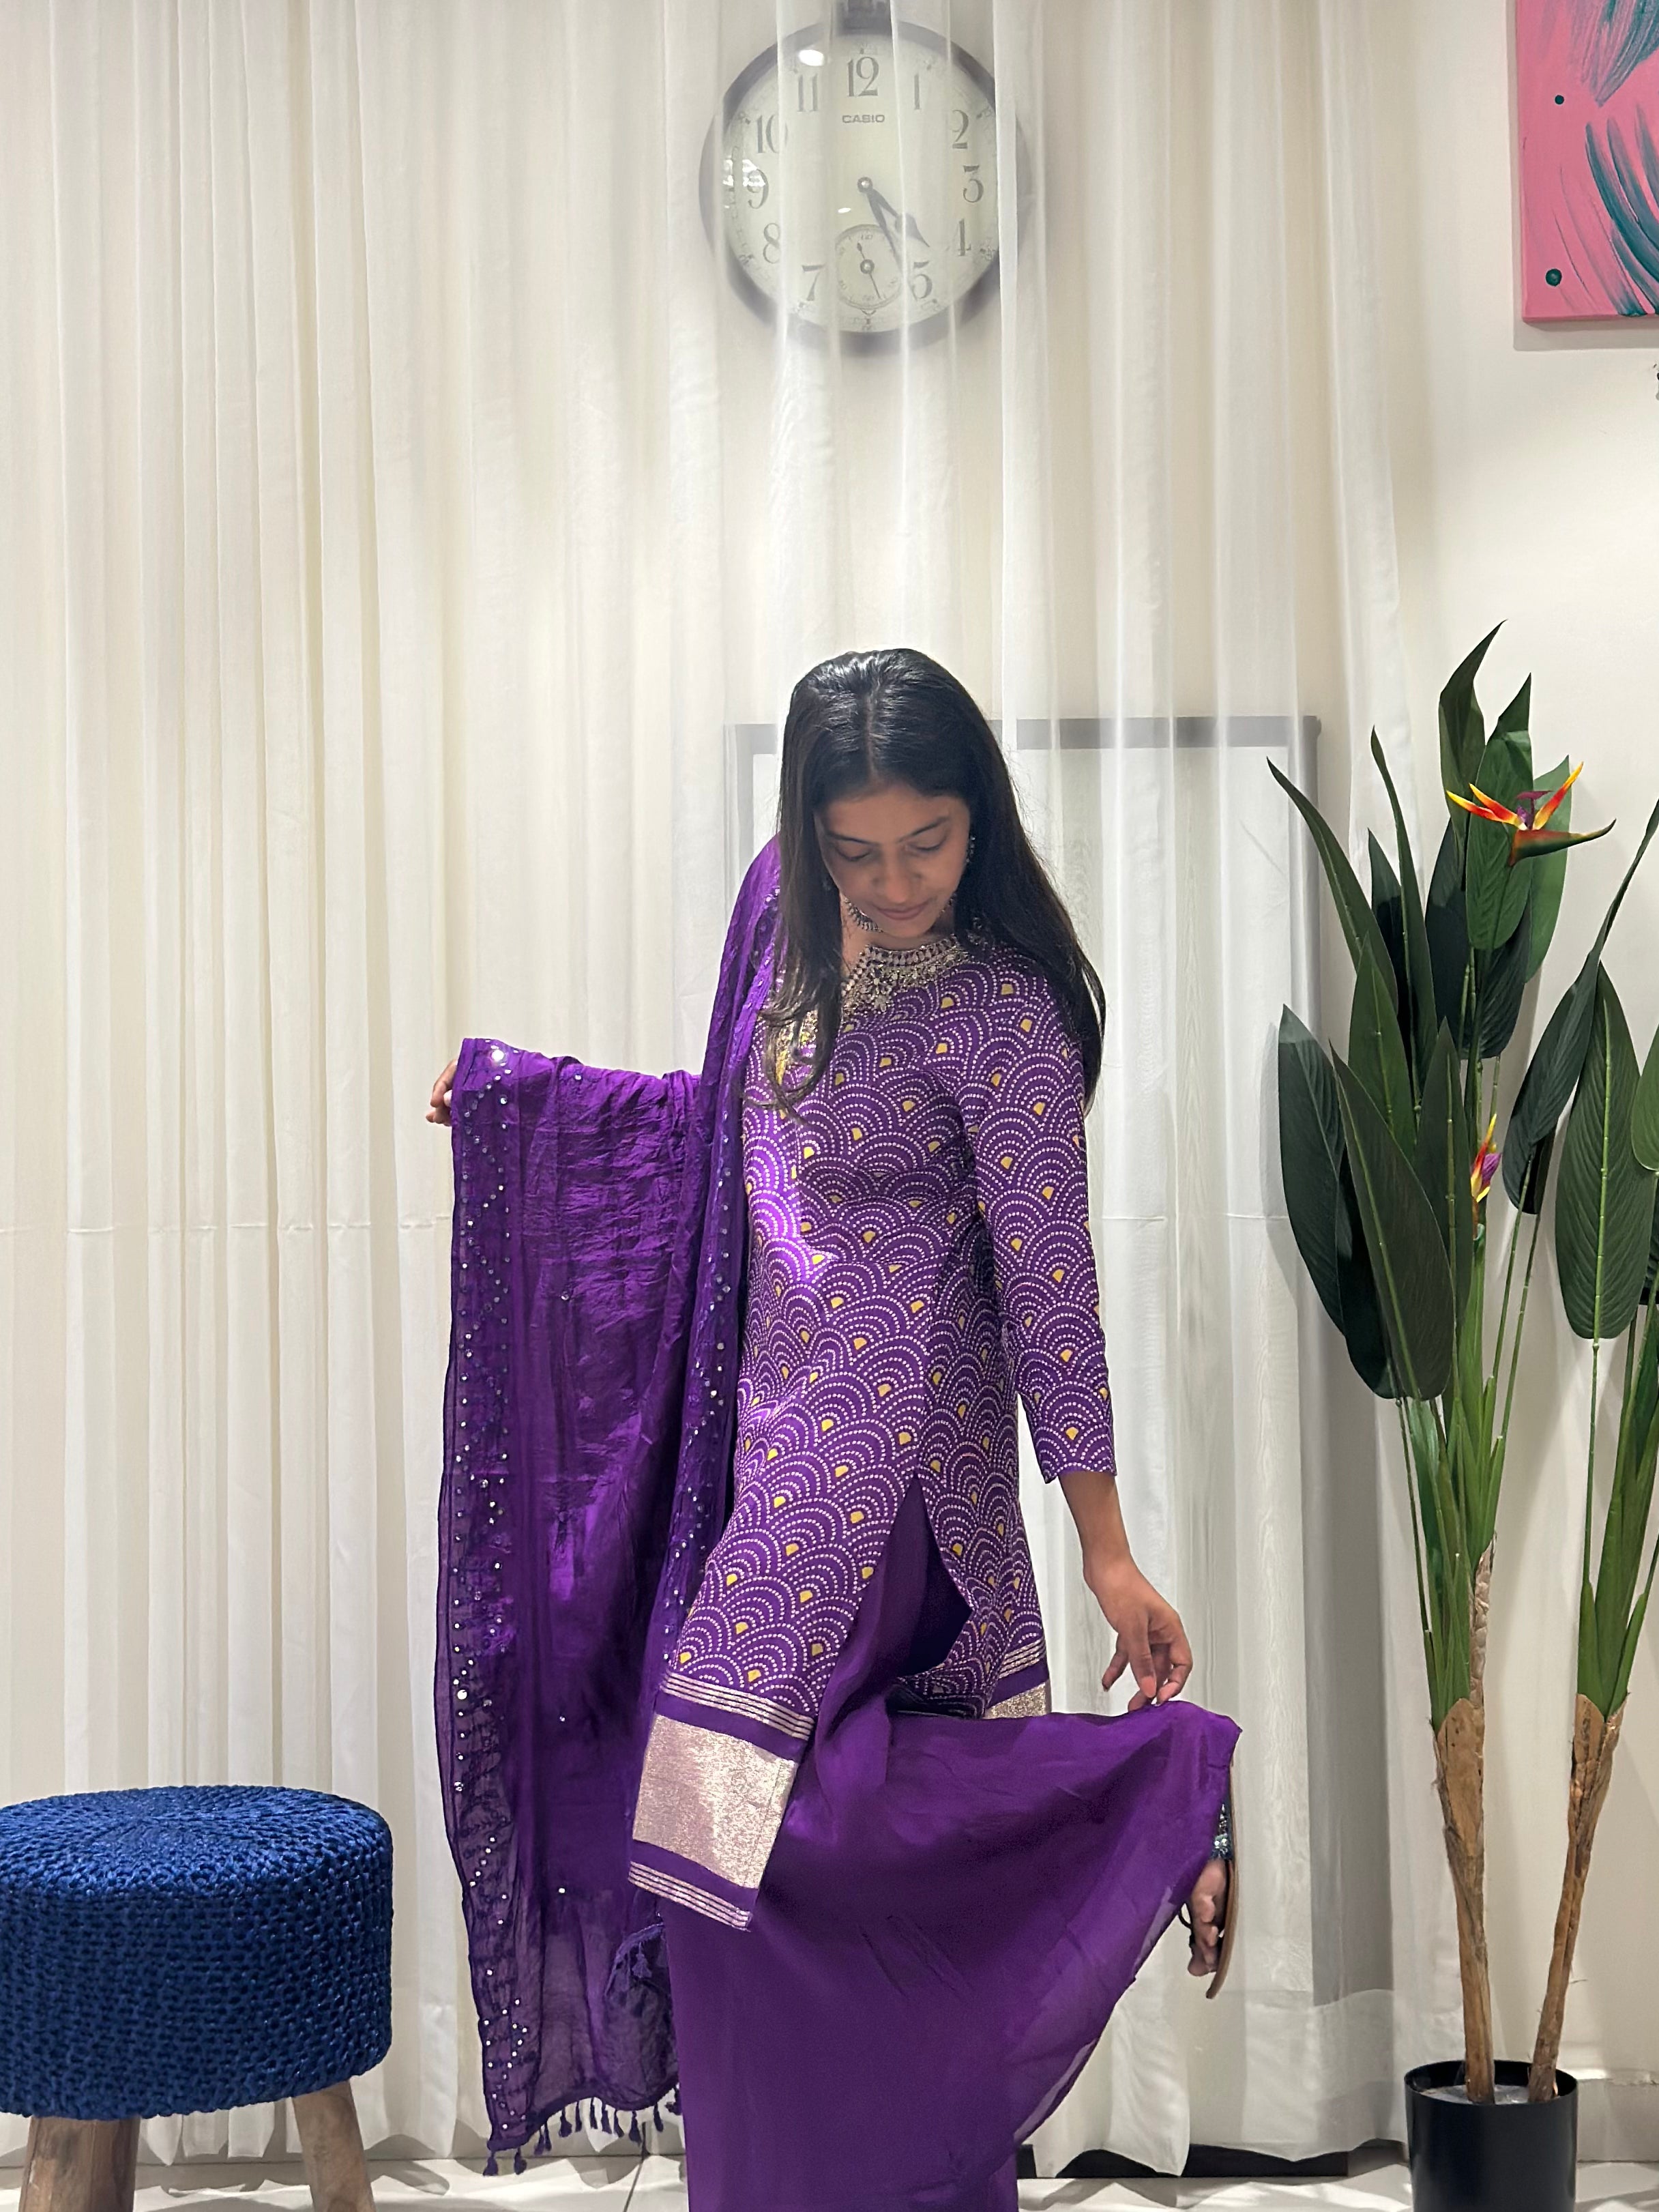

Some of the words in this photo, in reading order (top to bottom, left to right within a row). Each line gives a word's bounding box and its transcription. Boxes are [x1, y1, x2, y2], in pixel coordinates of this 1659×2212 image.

[797, 73, 819, 112] 11
[847, 56, 880, 97] 12
[913, 73, 921, 110] 1
[756, 114, 788, 154] 10
[842, 115, 885, 123] CASIO
[951, 109, 969, 149] 2
[746, 168, 769, 209] 9
[763, 222, 781, 264] 8
[802, 263, 827, 301] 7
[912, 260, 933, 300] 5
